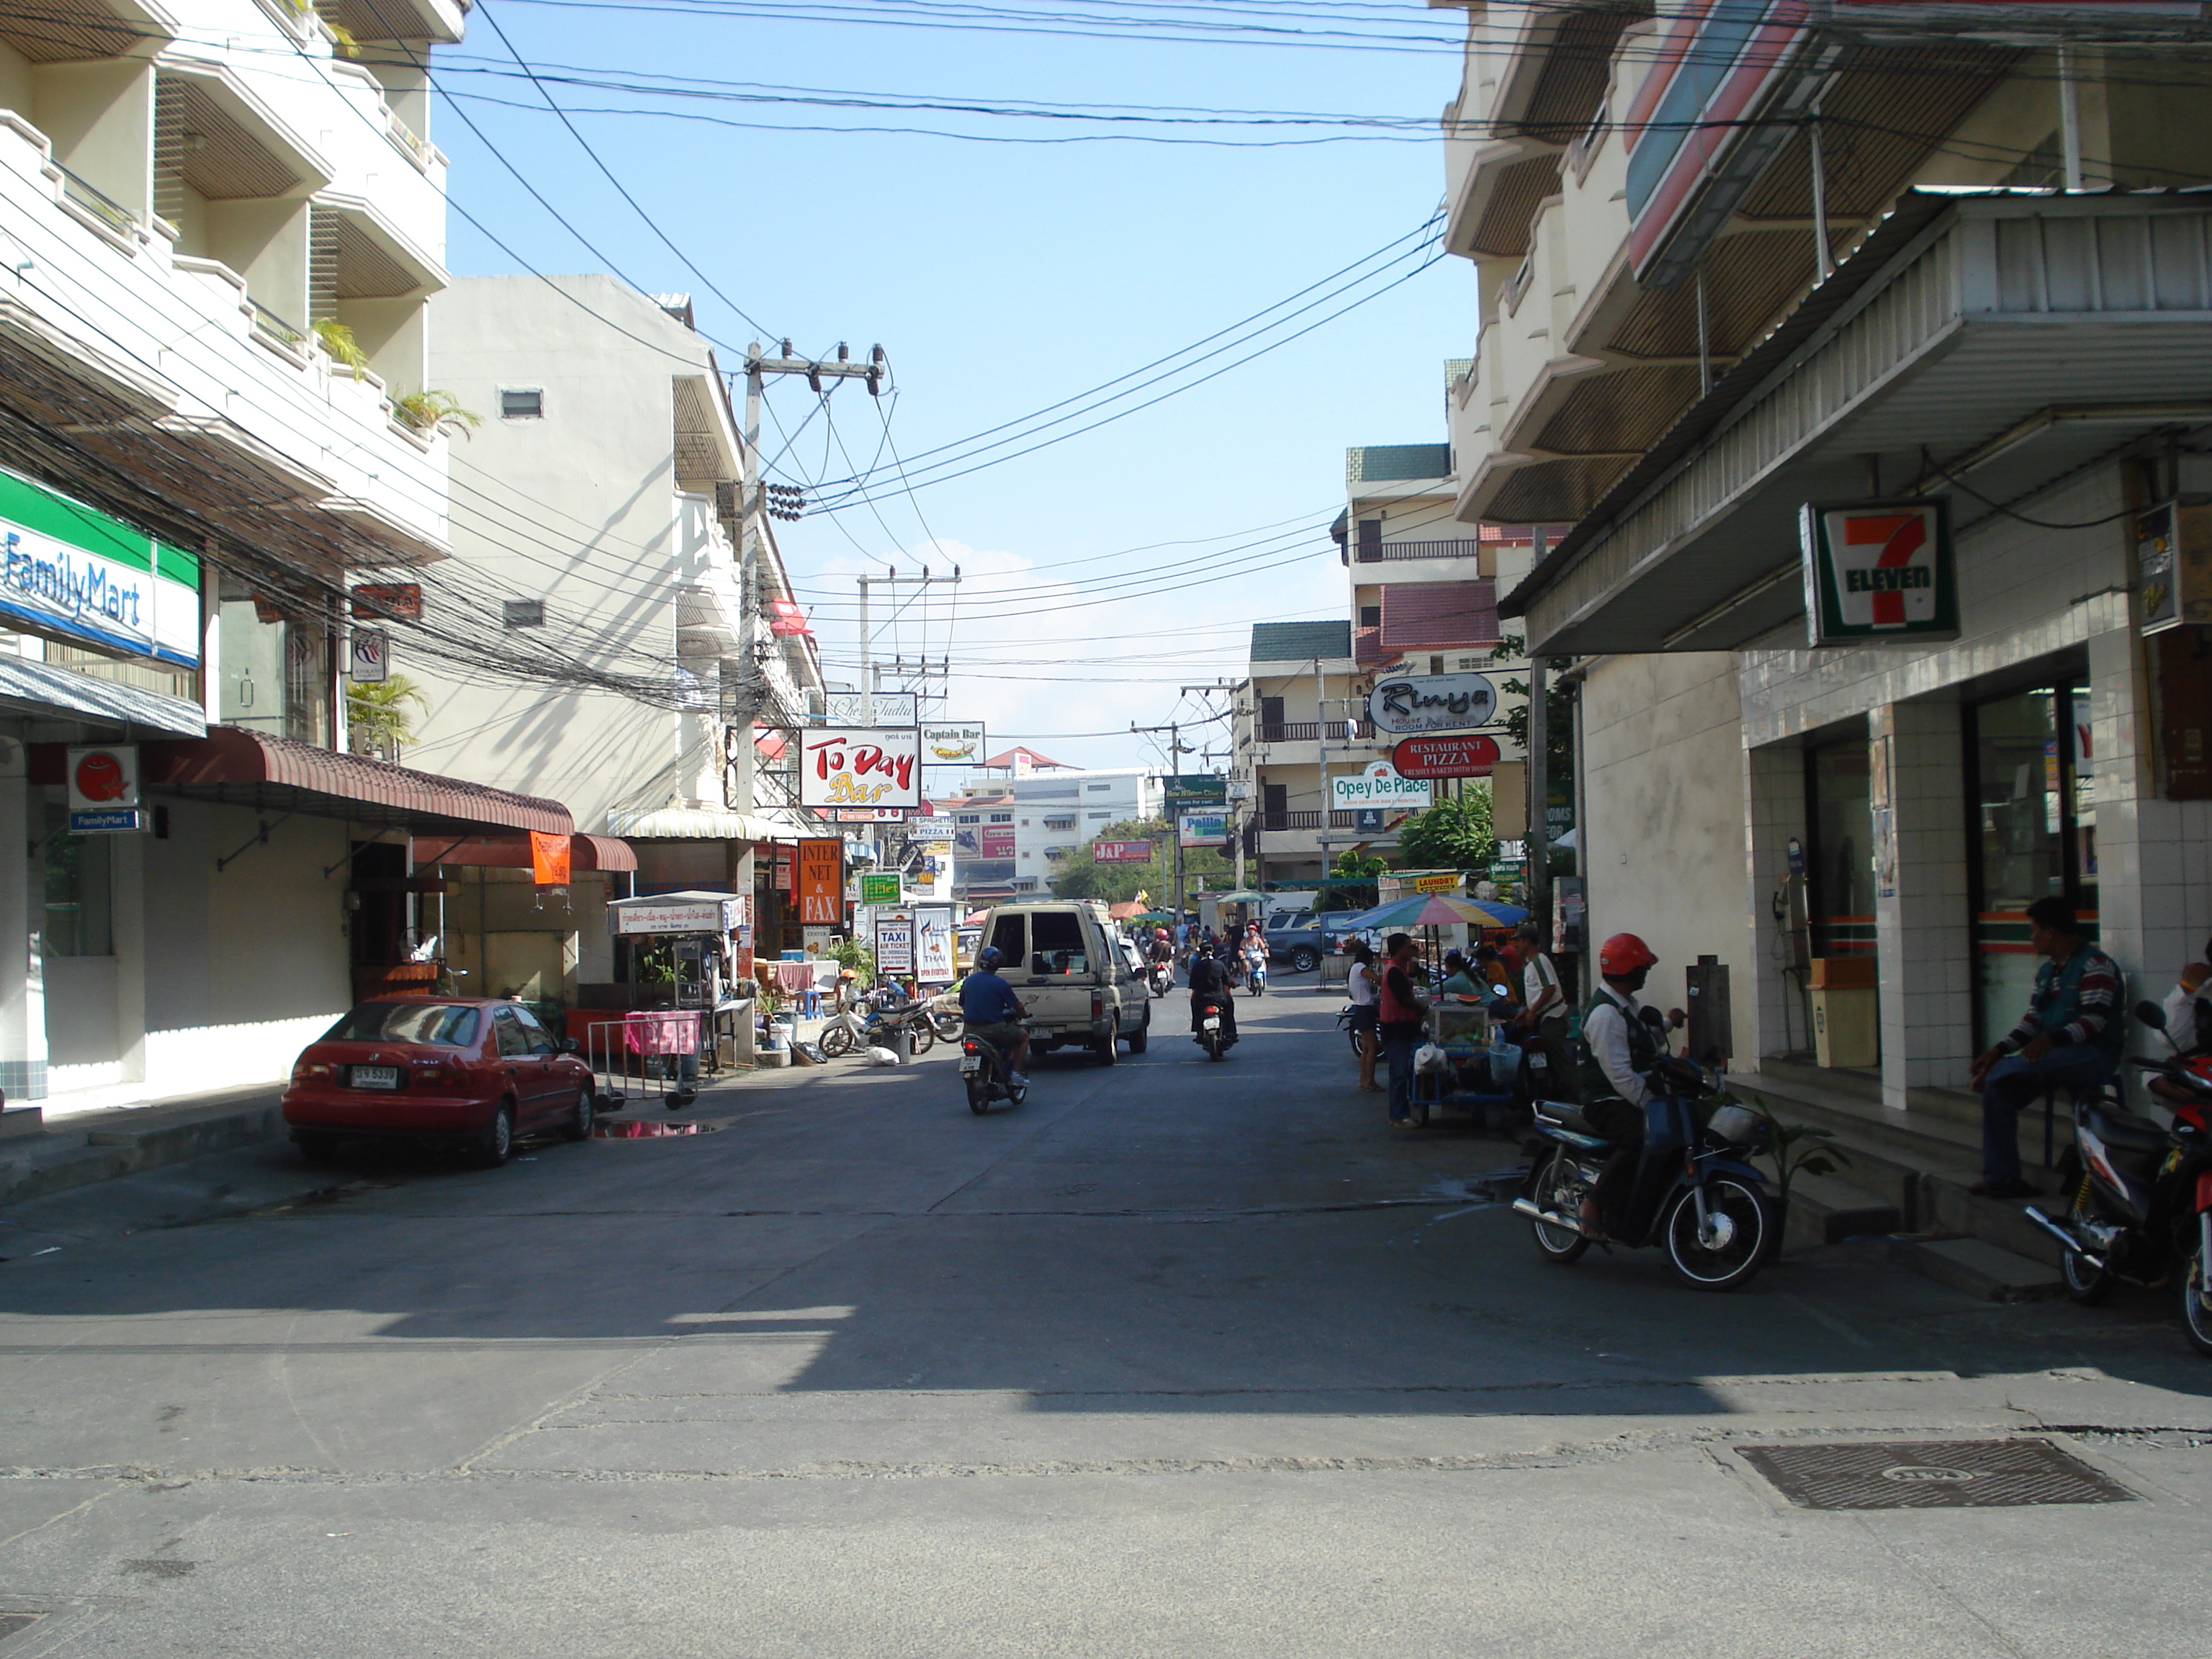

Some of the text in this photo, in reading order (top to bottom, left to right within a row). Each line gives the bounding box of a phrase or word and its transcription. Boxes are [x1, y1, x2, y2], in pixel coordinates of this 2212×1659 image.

[6, 531, 140, 626] FamilyMart
[1381, 683, 1488, 715] Rinya
[1395, 723, 1422, 732] ROOM
[924, 729, 981, 742] Captain Bar
[1410, 741, 1482, 754] RESTAURANT
[1423, 752, 1470, 766] PIZZA
[824, 771, 893, 804] Bar
[1336, 778, 1428, 800] Opey De Place
[78, 815, 128, 827] FamilyMart
[1547, 807, 1572, 822] OMS
[803, 845, 838, 861] INTER
[1096, 843, 1125, 858] J&P
[809, 865, 832, 881] NET
[1419, 876, 1455, 886] LAUNDRY
[815, 884, 824, 894] &
[805, 896, 836, 921] FAX
[881, 932, 906, 942] TAXI
